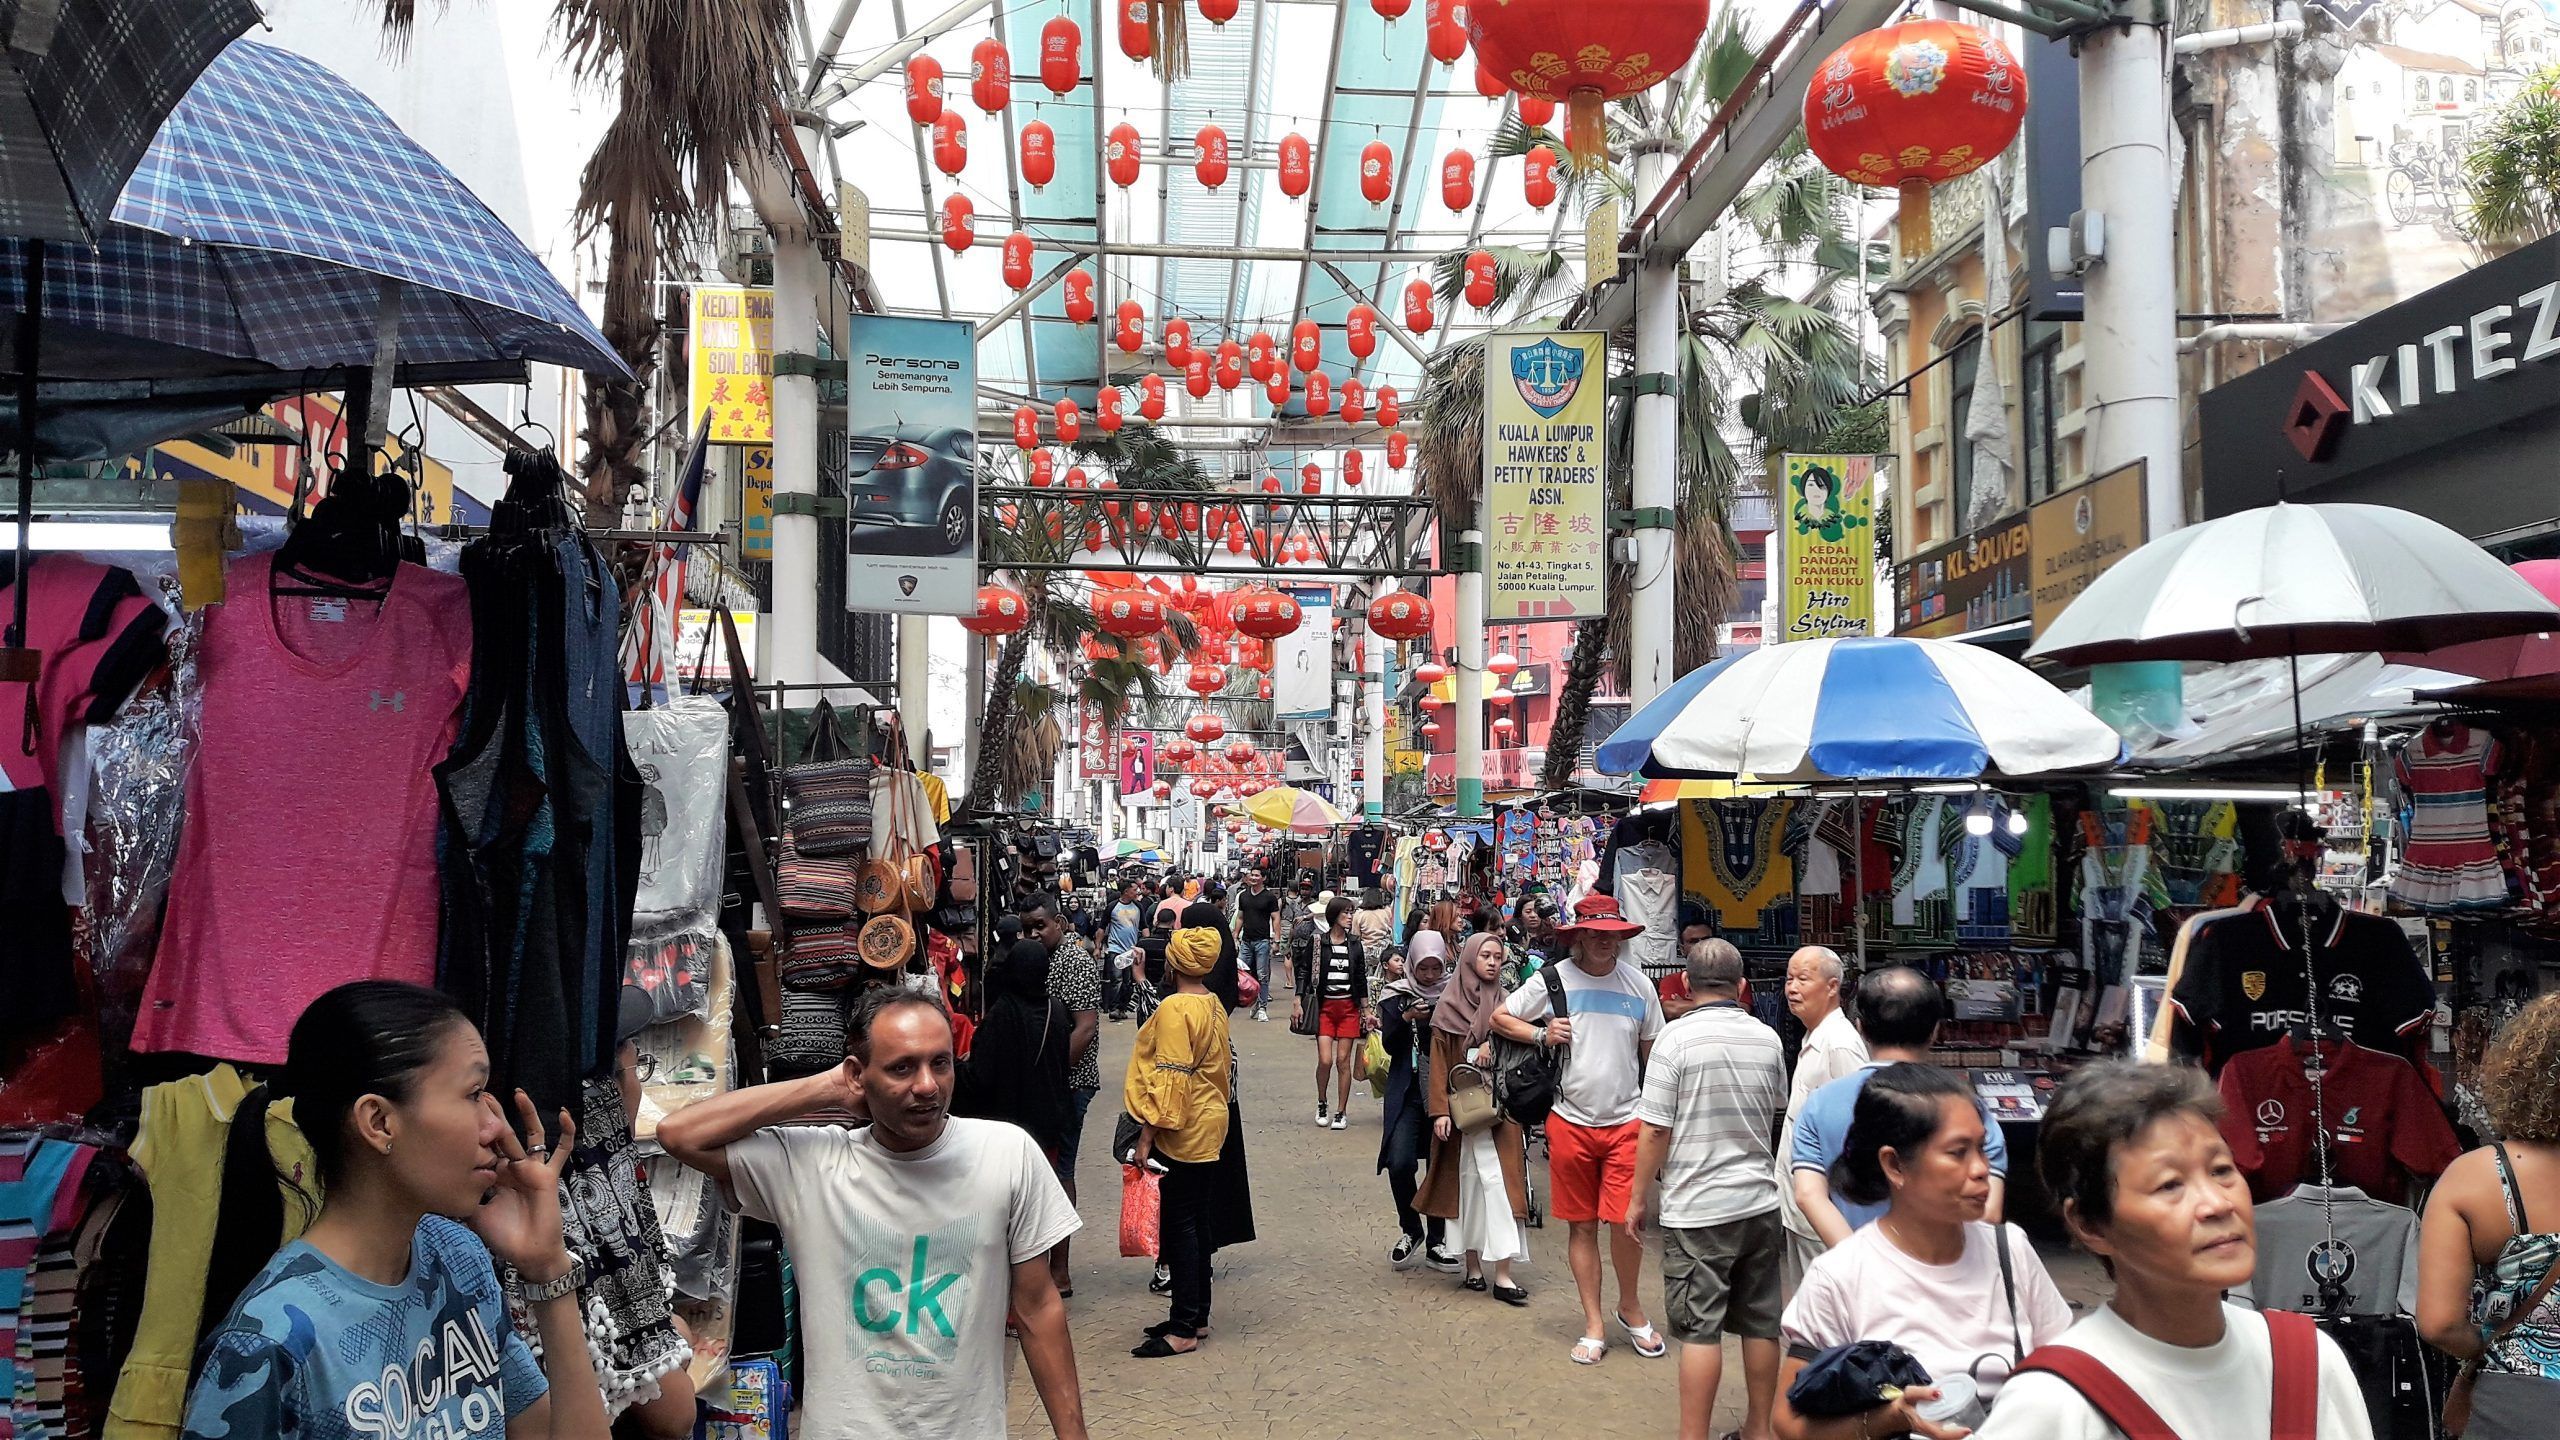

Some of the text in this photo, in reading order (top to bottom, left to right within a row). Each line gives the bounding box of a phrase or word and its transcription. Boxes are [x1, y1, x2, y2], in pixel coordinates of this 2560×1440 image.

[702, 295, 739, 318] KEDAI
[961, 325, 968, 336] 1
[708, 352, 773, 376] SDN. BHD.
[866, 354, 960, 370] Persona
[877, 370, 949, 383] Sememangnya
[872, 381, 953, 394] Lebih Sempurna.
[1499, 424, 1594, 443] KUALA LUMPUR
[1508, 443, 1586, 463] HAWKERS' &
[1494, 465, 1598, 484] PETTY TRADERS'
[1528, 488, 1565, 505] ASSN.
[1497, 511, 1595, 536] 吉隆坡
[1493, 540, 1601, 555] 小販商業公會
[1809, 545, 1849, 554] KEDAI
[1497, 561, 1593, 572] No. 41-43, Tingkat 5,
[1800, 556, 1859, 565] DANDAN
[1947, 552, 1967, 581] KL
[1497, 572, 1568, 583] Jalan Petaling,
[1800, 567, 1858, 575] RAMBUT
[1497, 583, 1597, 593] 50000 Kuala Lumpur.
[1794, 577, 1864, 586] DAN KUKU
[1806, 591, 1850, 609] Hiro
[1983, 1071, 2016, 1084] KYLIE
[853, 1235, 961, 1338] ck
[865, 1358, 935, 1380] Calvin Klein
